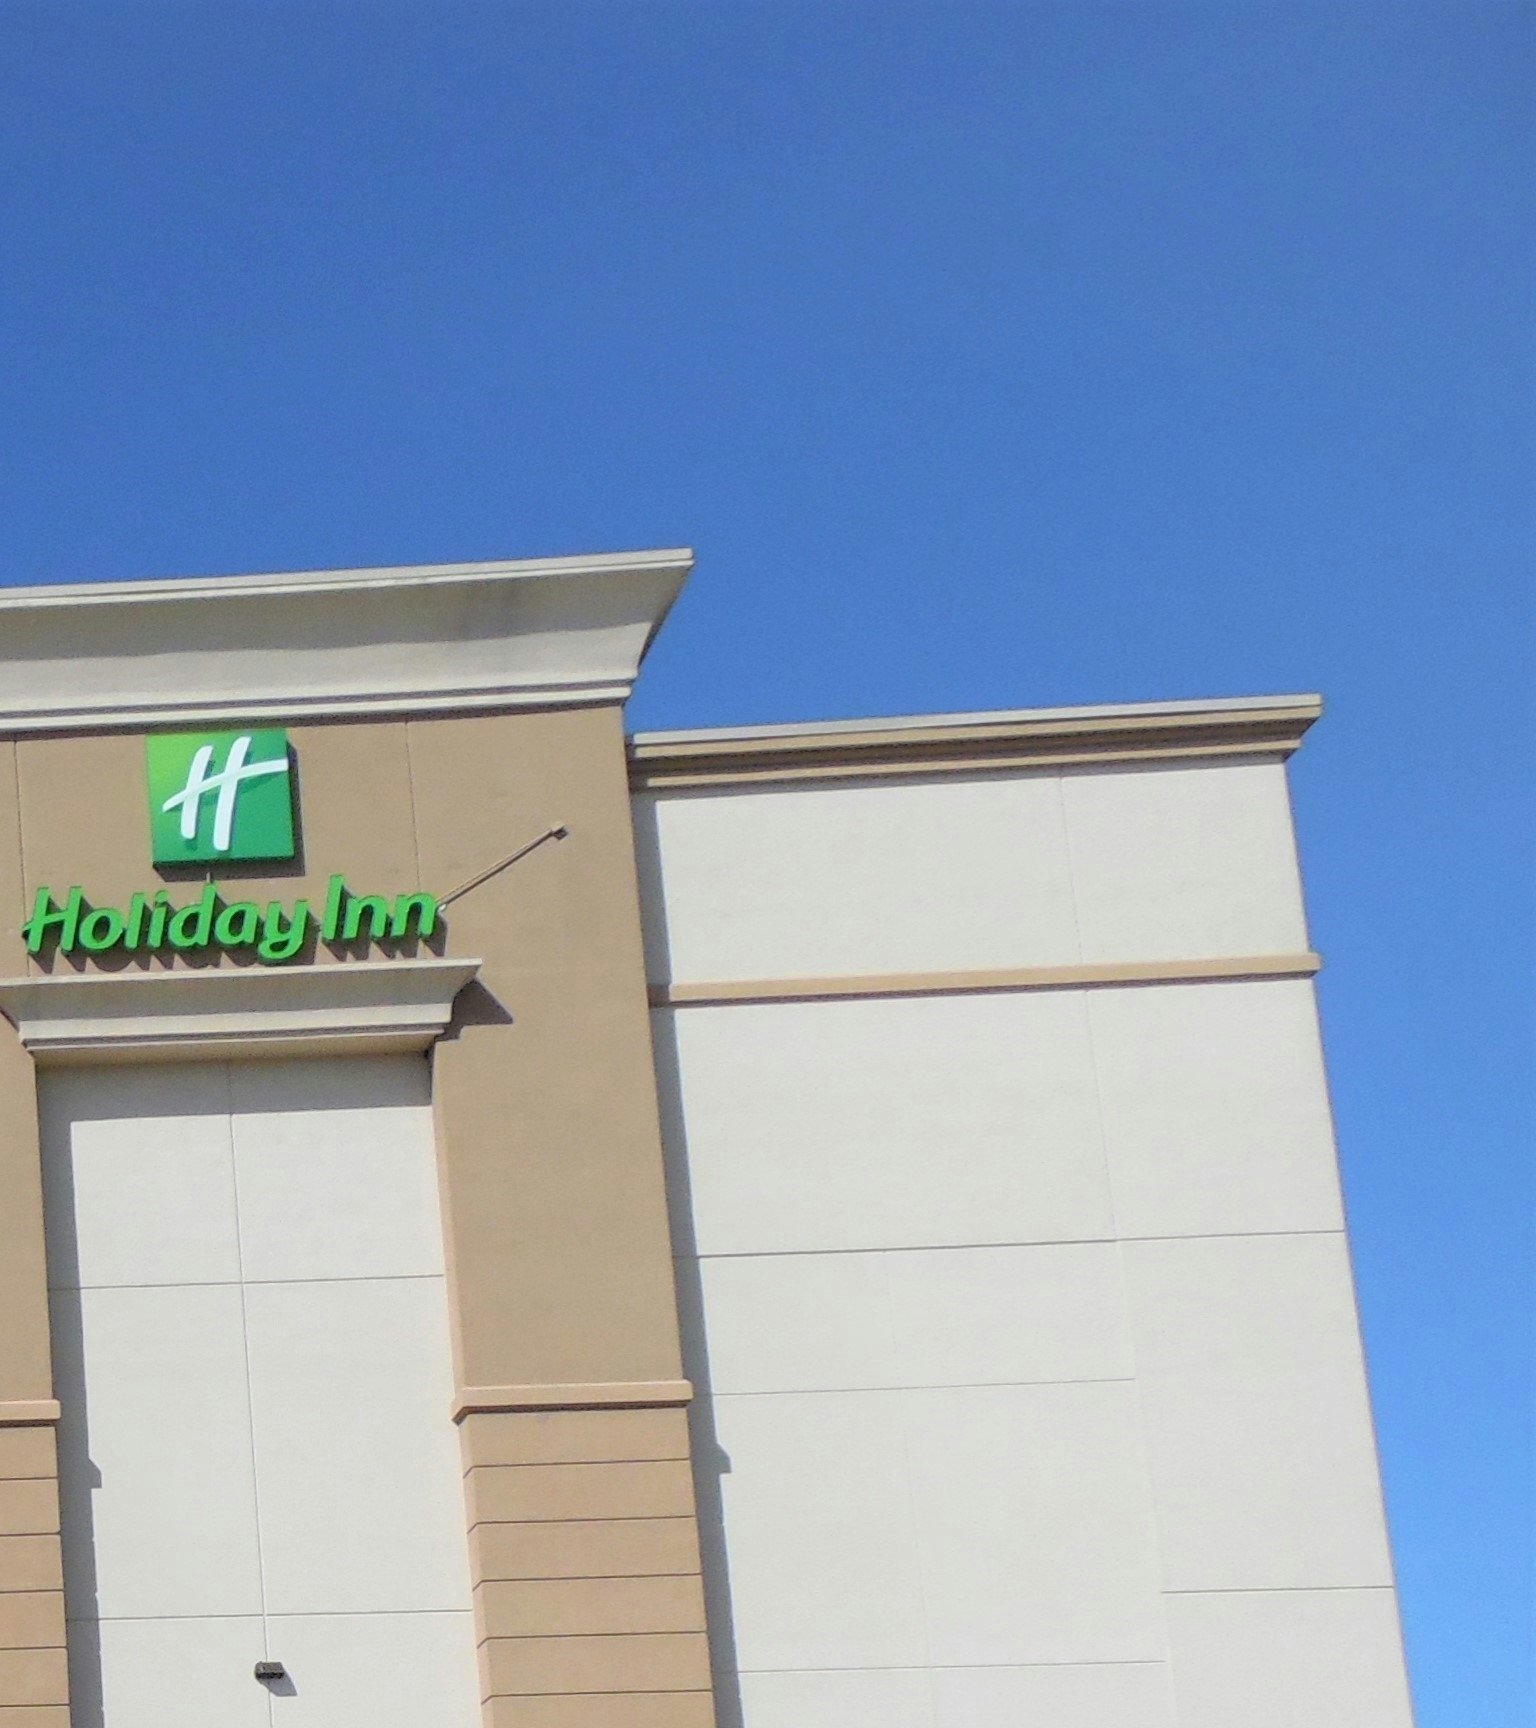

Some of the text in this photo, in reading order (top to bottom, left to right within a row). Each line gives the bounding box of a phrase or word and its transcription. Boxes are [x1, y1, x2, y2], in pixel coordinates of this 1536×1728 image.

[162, 736, 288, 851] H
[22, 875, 440, 961] Holiday Inn
